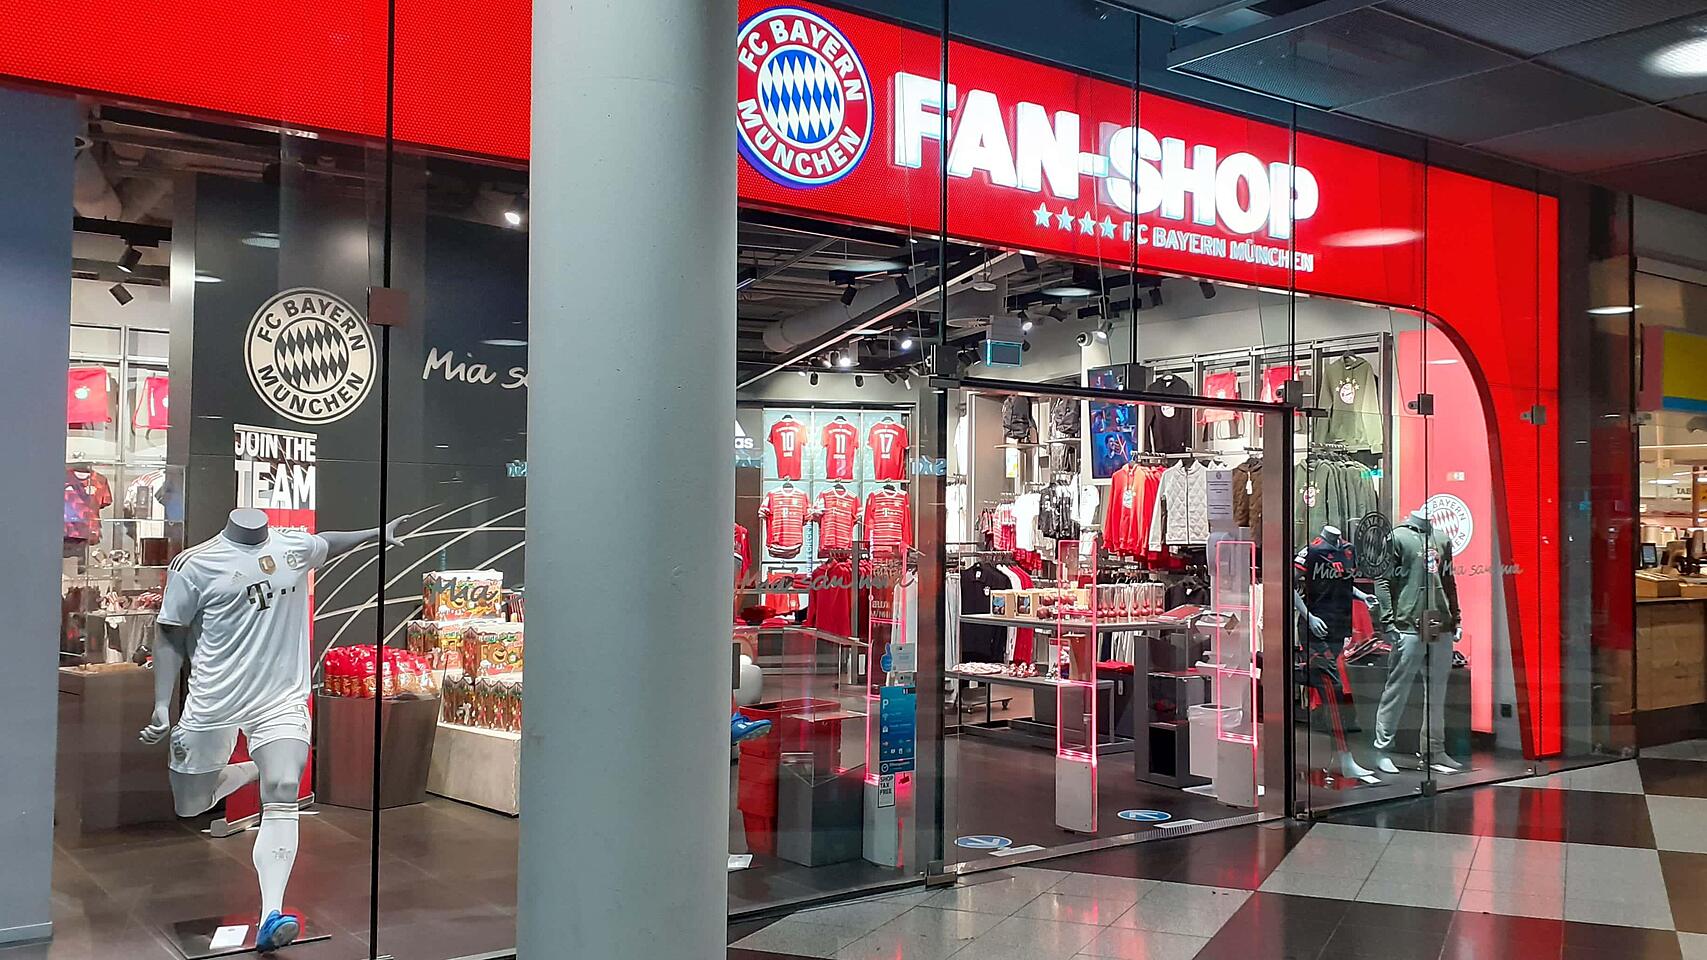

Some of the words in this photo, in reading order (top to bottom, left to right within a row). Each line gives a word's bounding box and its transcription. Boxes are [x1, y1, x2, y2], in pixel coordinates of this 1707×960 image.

[738, 30, 769, 73] FC
[771, 18, 865, 102] BAYERN
[738, 98, 863, 178] MÜNCHEN
[893, 72, 1319, 241] FAN-SHOP
[1122, 221, 1149, 245] FC
[1152, 226, 1226, 257] BAYERN
[1230, 239, 1315, 272] MÜNCHEN
[257, 309, 282, 343] FC
[283, 297, 366, 352] BAYERN
[257, 364, 364, 415] MÜNCHEN
[422, 347, 497, 384] Mia
[234, 430, 279, 459] JOIN
[282, 436, 316, 462] THE
[880, 434, 894, 455] 17
[235, 460, 316, 510] TEAM
